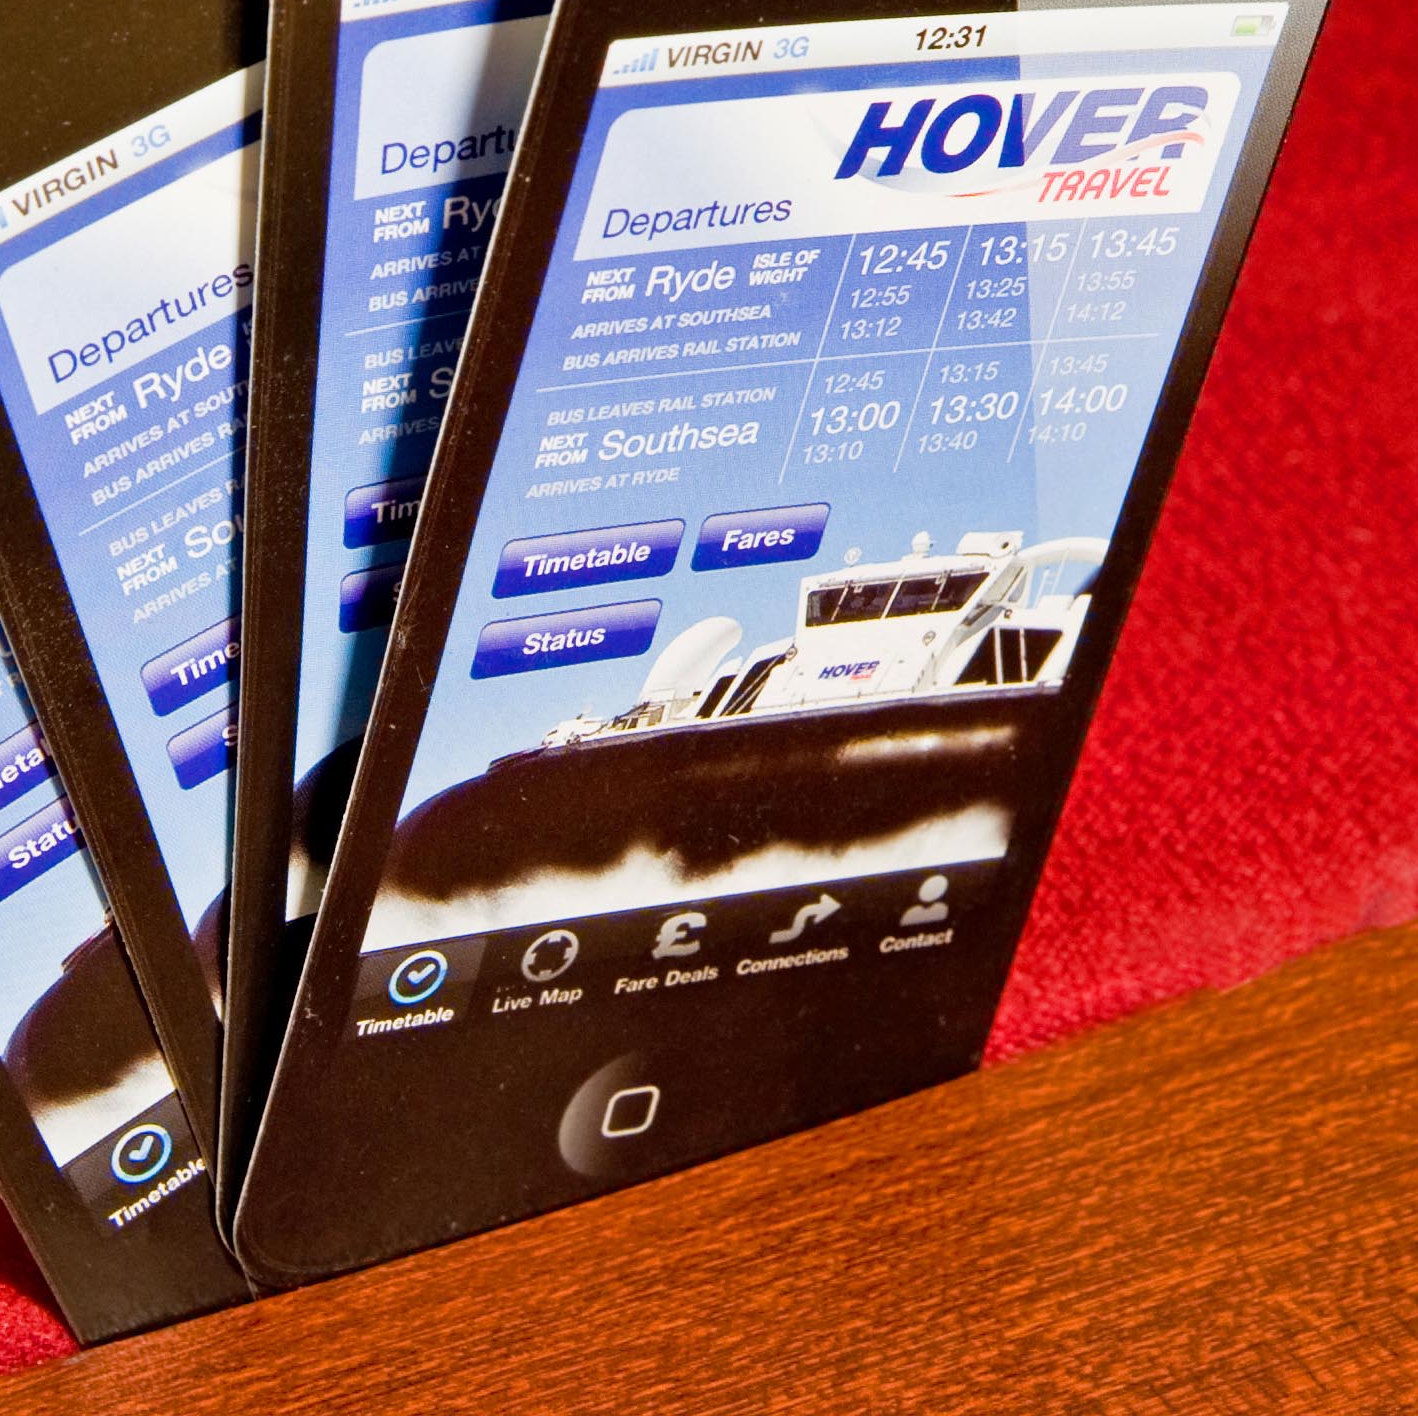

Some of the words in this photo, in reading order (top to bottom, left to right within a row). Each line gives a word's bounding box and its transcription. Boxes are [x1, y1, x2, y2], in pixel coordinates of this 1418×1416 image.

[667, 40, 764, 69] VIRGIN
[772, 36, 811, 60] 3G
[915, 25, 988, 52] 12:31
[833, 85, 1210, 181] HOVER
[12, 149, 118, 217] VIRGIN
[130, 124, 171, 158] 3G
[1037, 166, 1171, 203] TRAVEL
[373, 217, 430, 243] FROM
[374, 201, 427, 225] NEXT
[602, 198, 793, 241] Departures
[370, 251, 452, 280] ARRIVES
[752, 252, 792, 270] ISLE
[795, 249, 822, 265] OF
[859, 240, 952, 276] 12:45
[980, 232, 1070, 267] 13:15
[1090, 226, 1180, 260] 13:45
[581, 284, 636, 304] FROM
[586, 267, 636, 287] NEXT
[644, 260, 737, 303] Ryde
[748, 267, 808, 286] WIGHT
[850, 284, 912, 310] 12:55
[965, 276, 1027, 301] 13:25
[1076, 270, 1137, 292] 13:55
[368, 290, 409, 312] BUS
[48, 263, 254, 383] Departures
[570, 318, 648, 340] ARRIVES
[650, 315, 678, 330] AT
[676, 304, 771, 328] SOUTHSEA
[840, 316, 903, 341] 13:12
[956, 307, 1018, 331] 13:42
[1065, 300, 1126, 324] 14:12
[364, 348, 404, 369] BUS
[562, 352, 601, 372] BUS
[602, 344, 679, 367] ARRIVES
[681, 340, 721, 357] RAIL
[725, 331, 802, 352] STATION
[133, 344, 233, 409] Ryde
[362, 372, 412, 396] NEXT
[824, 370, 886, 395] 12:45
[939, 361, 1000, 384] 13:15
[1049, 354, 1109, 376] 13:45
[64, 390, 115, 429] NEXT
[361, 389, 417, 414] FROM
[546, 409, 583, 427] BUS
[587, 402, 654, 422] LEAVES
[657, 397, 696, 413] RAIL
[700, 386, 777, 408] STATION
[809, 400, 901, 436] 13:00
[930, 391, 1020, 426] 13:30
[1039, 384, 1128, 416] 14:00
[70, 403, 128, 446] FROM
[83, 424, 164, 478] ARRIVES
[167, 409, 190, 433] AT
[359, 416, 440, 445] ARRIVES
[539, 433, 589, 452] NEXT
[597, 421, 760, 461] Southsea
[534, 449, 588, 469] FROM
[802, 440, 864, 465] 13:10
[917, 430, 979, 455] 13:40
[1027, 423, 1087, 445] 14:10
[91, 475, 132, 507] BUS
[136, 431, 215, 484] ARRIVES
[524, 477, 602, 499] ARRIVES
[604, 474, 631, 489] AT
[632, 467, 681, 484] RYDE
[109, 527, 149, 557] BUS
[151, 487, 223, 535] LEAVES
[116, 543, 166, 581] NEXT
[523, 541, 652, 578] Timetable
[721, 527, 796, 552] Fares
[121, 555, 178, 596] FROM
[133, 572, 212, 624] ARRIVES
[216, 557, 236, 581] AT
[522, 627, 606, 656] Status
[818, 660, 880, 679] HOVER
[879, 928, 954, 954] Contact
[736, 945, 849, 976] Connections
[614, 976, 659, 995] Fare
[664, 965, 720, 986] Deals
[491, 993, 533, 1014] Live
[538, 986, 583, 1007] Map
[355, 1006, 455, 1037] Timetable
[108, 1158, 206, 1227] Timetable
